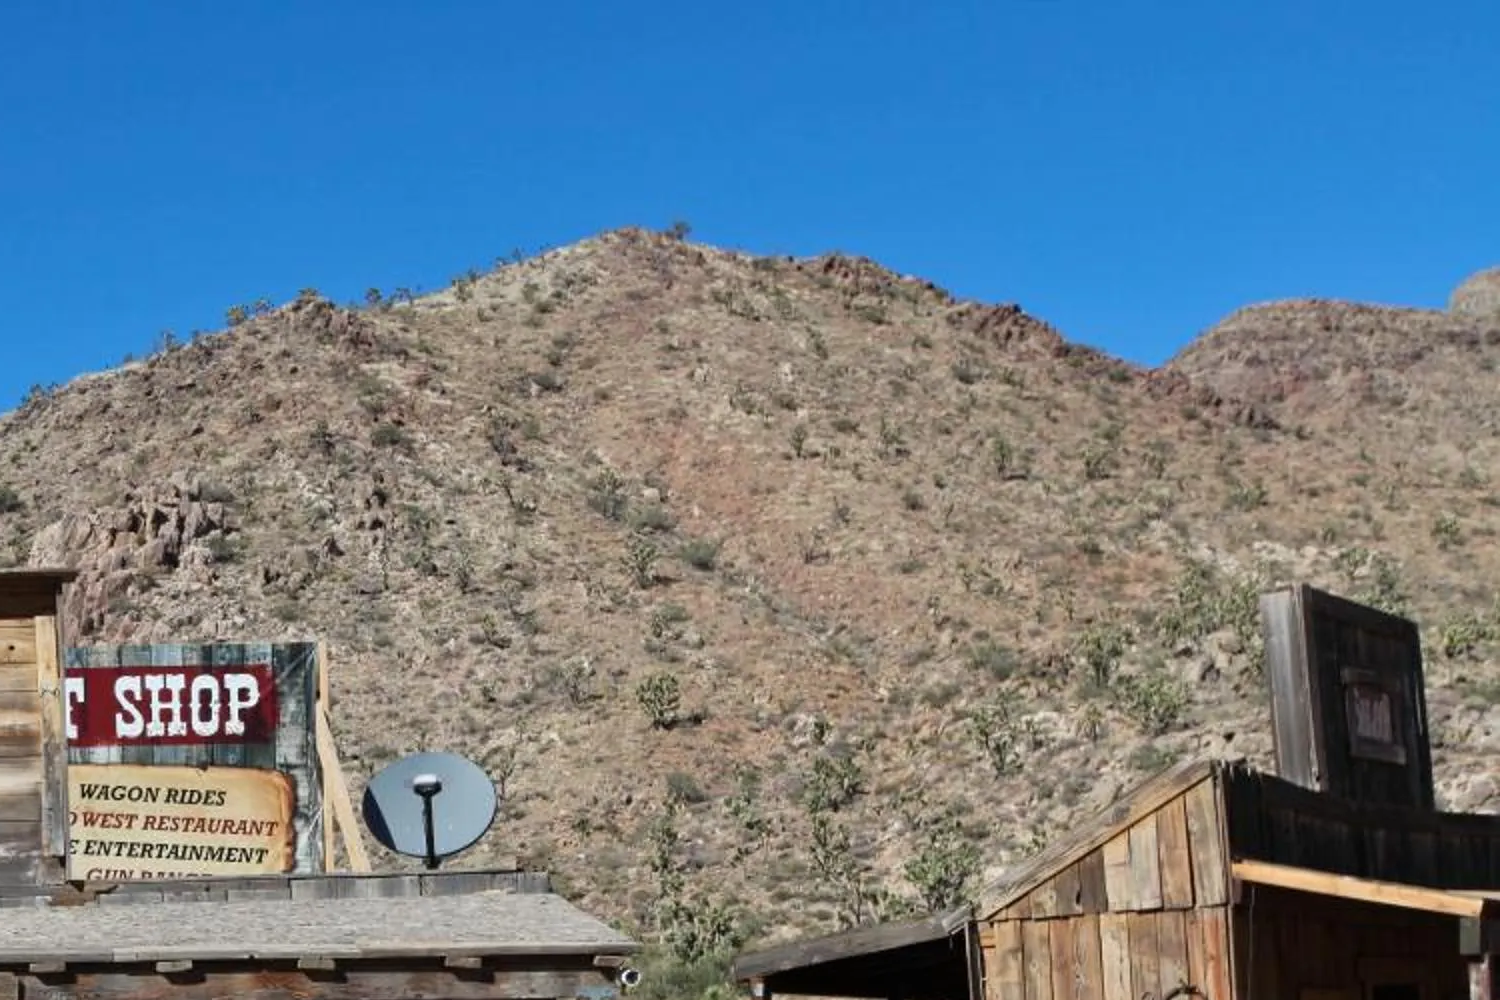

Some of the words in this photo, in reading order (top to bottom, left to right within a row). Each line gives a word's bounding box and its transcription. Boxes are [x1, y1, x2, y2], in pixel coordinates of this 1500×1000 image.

[114, 673, 260, 739] SHOP
[80, 783, 161, 803] WAGON
[163, 787, 227, 807] RIDES
[82, 811, 138, 829] WEST
[142, 814, 279, 837] RESTAURANT
[83, 839, 269, 865] ENTERTAINMENT
